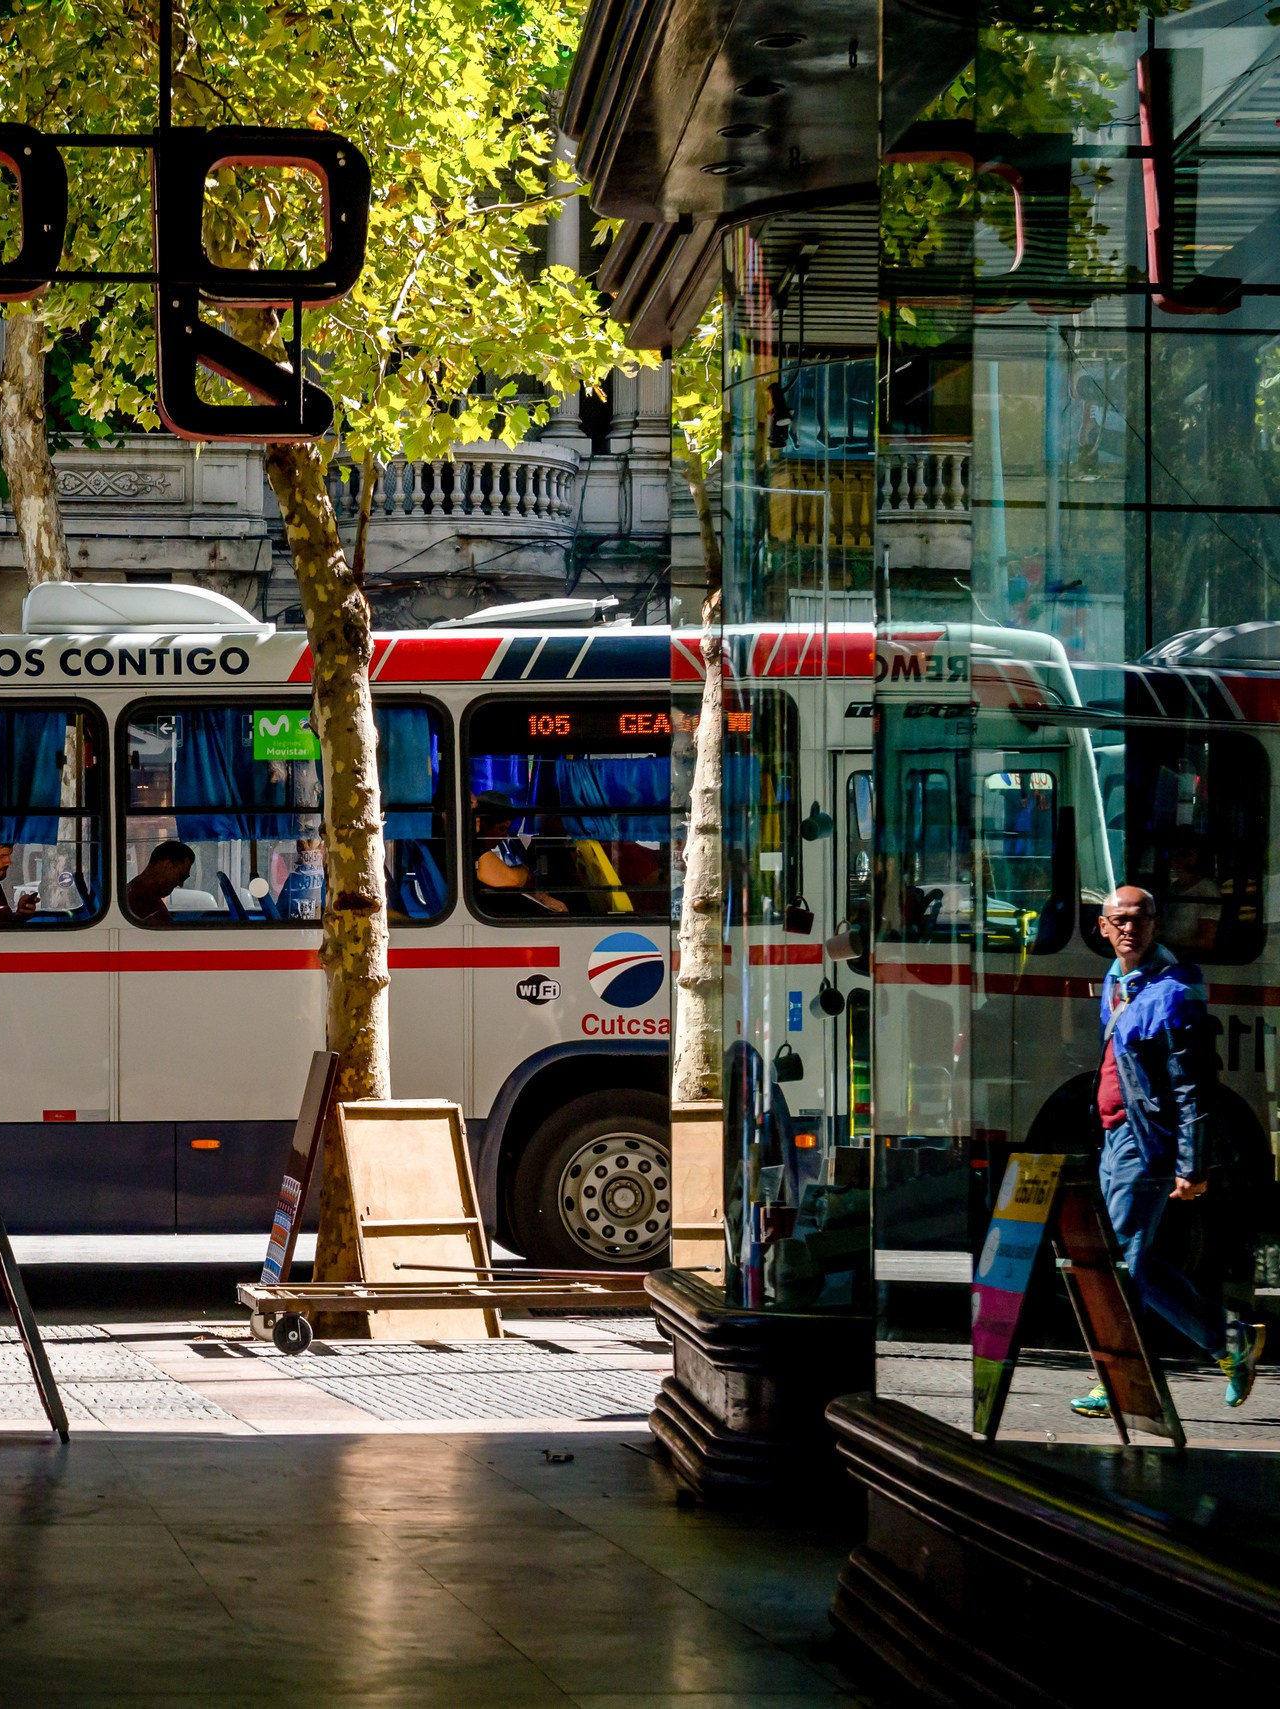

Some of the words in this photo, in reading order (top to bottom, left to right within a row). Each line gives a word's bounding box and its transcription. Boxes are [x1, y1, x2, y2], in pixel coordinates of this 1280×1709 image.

[59, 647, 250, 675] CONTIGO
[528, 714, 570, 736] 105
[266, 747, 308, 756] Movistar
[581, 1013, 671, 1036] Cutcsa
